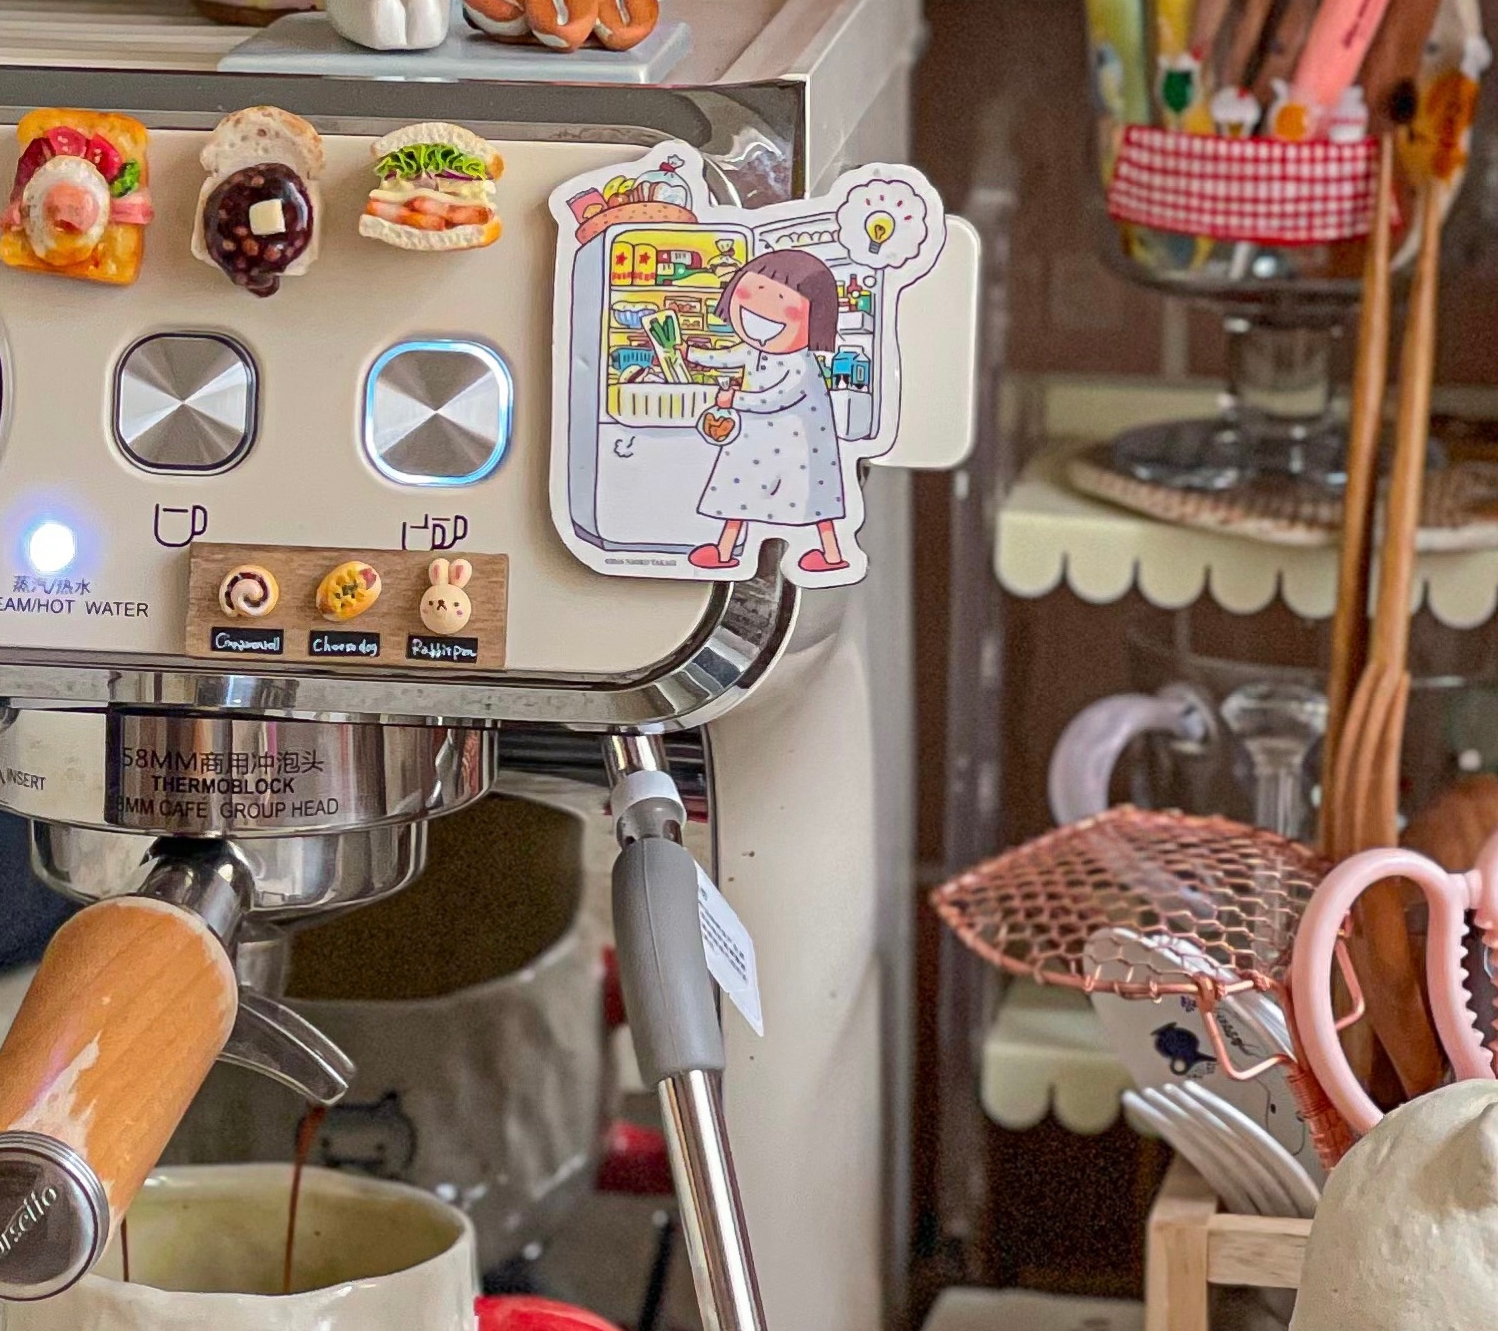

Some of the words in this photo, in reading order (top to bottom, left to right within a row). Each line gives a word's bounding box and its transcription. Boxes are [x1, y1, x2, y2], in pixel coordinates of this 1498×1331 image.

[12, 575, 92, 595] 蒸汽/热水
[85, 600, 150, 617] WATER
[122, 747, 325, 775] 58MM商用冲泡头
[6, 767, 46, 791] INSERT
[151, 774, 295, 795] THERMOBLOCK
[114, 795, 155, 816] 8MM
[220, 800, 286, 820] GROUP
[291, 797, 340, 818] HEAD
